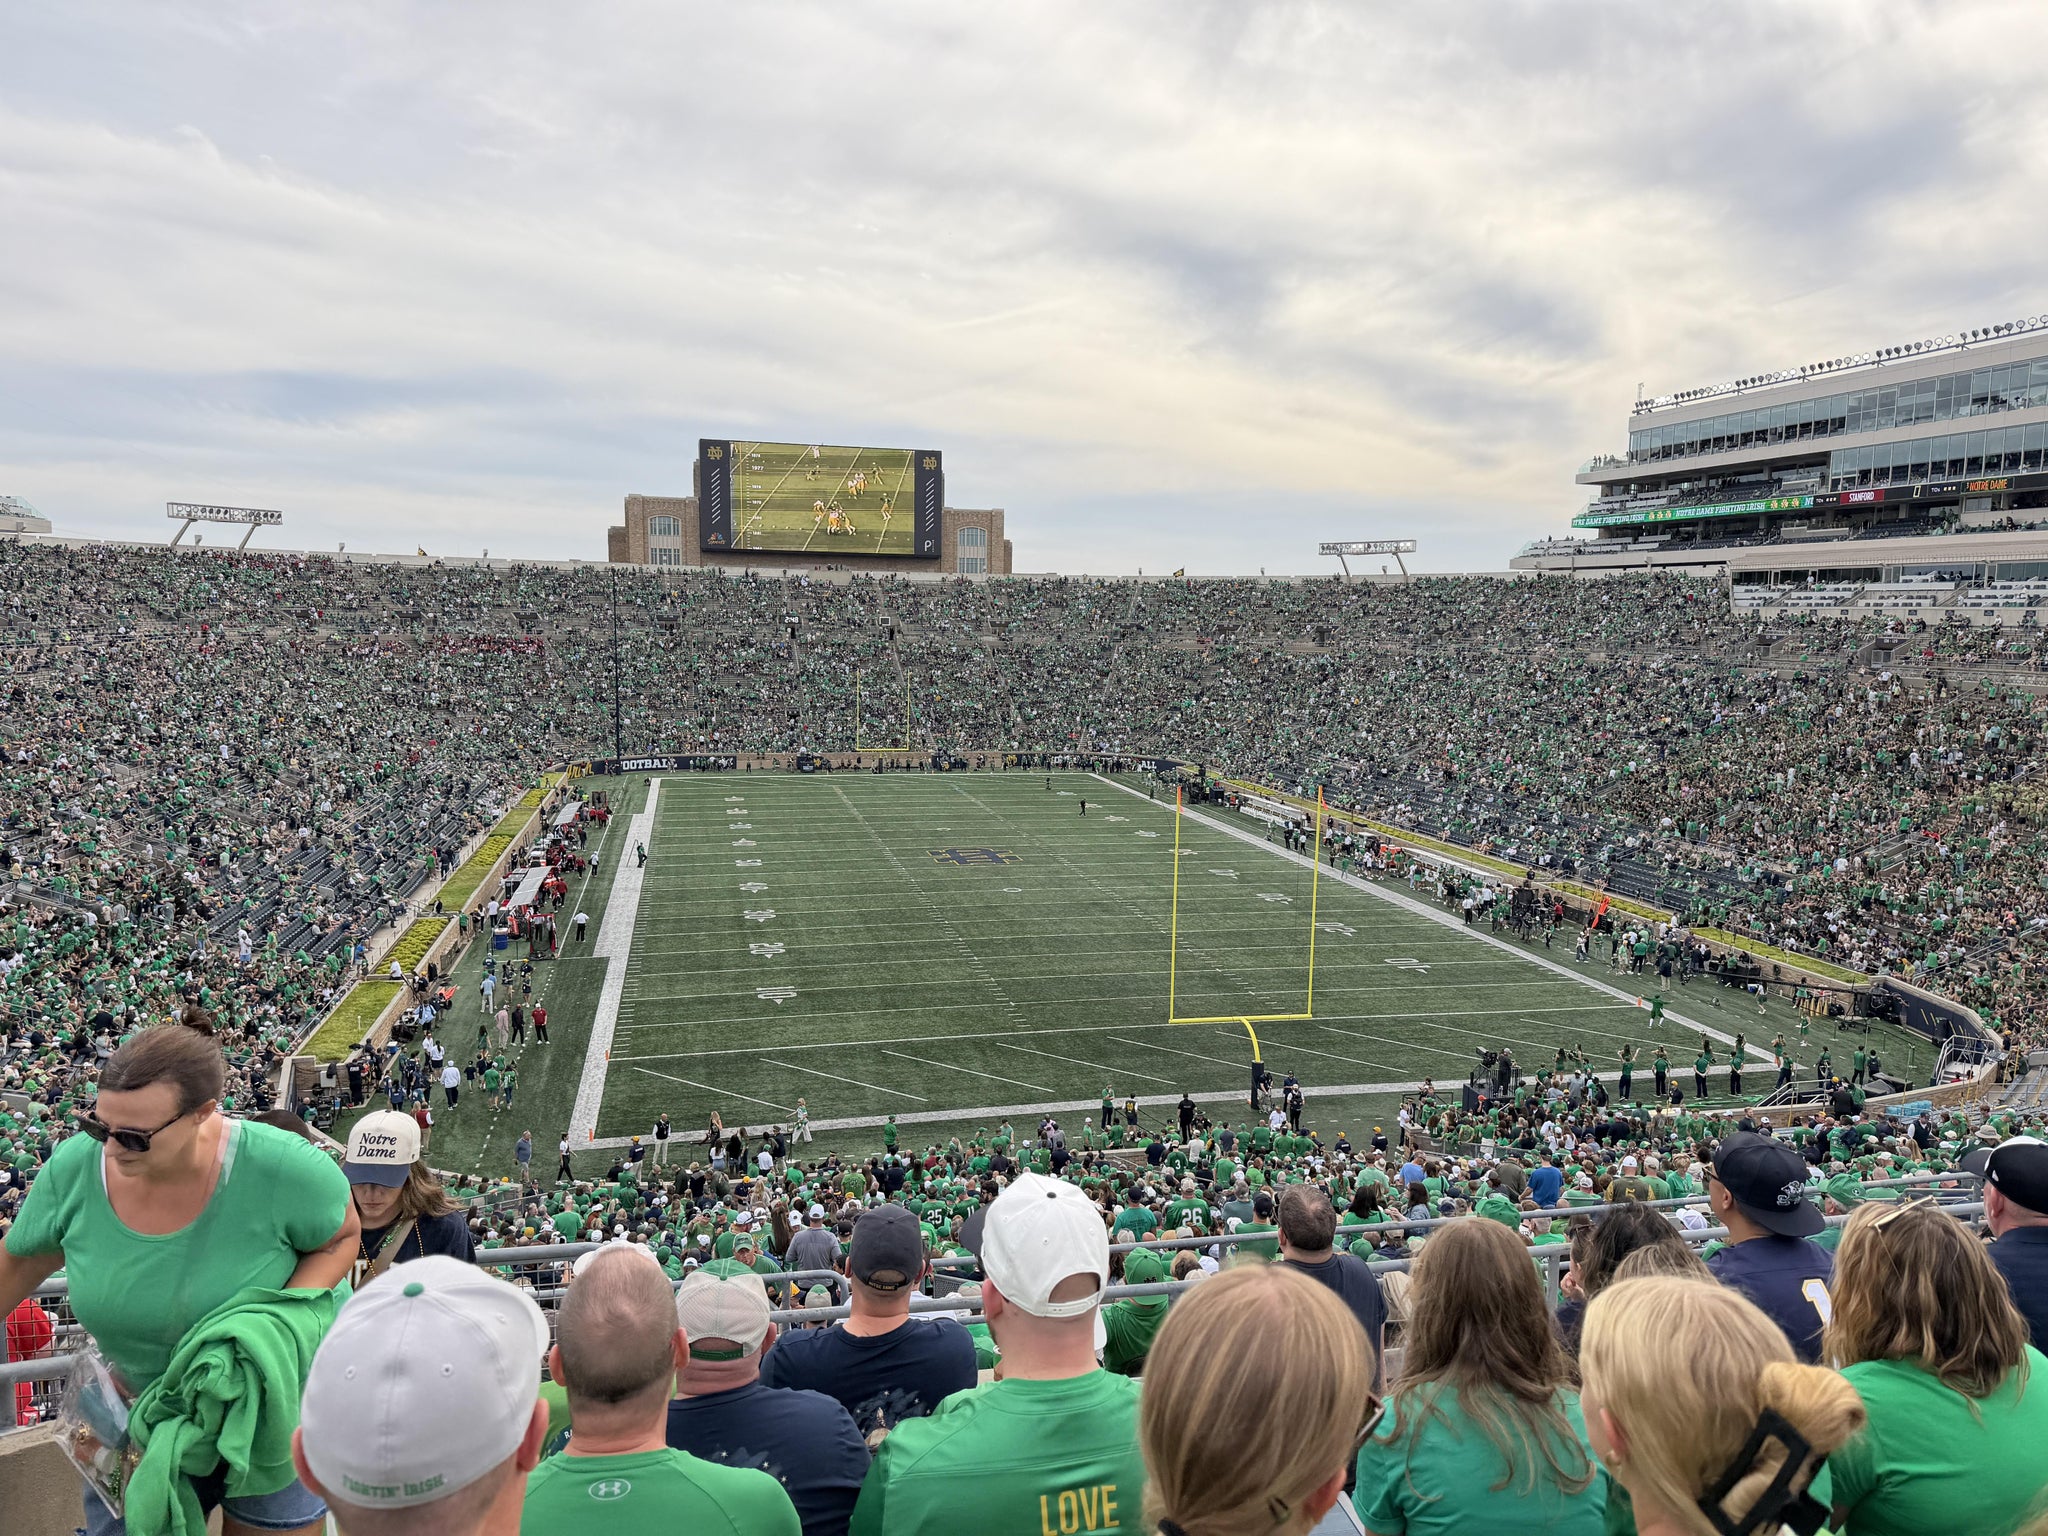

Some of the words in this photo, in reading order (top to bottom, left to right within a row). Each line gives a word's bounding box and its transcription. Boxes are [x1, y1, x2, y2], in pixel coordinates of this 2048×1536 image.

[1969, 480, 1988, 492] NOTRE
[1989, 478, 2008, 490] DAME
[1848, 491, 1875, 503] STANFORD
[1675, 508, 1695, 518] NOTRE
[1695, 506, 1715, 517] DAME
[1715, 503, 1746, 515] FIGHTING
[1745, 501, 1766, 512] IRISH
[784, 616, 799, 624] 2:48
[620, 758, 677, 771] OOTBAL
[359, 1132, 398, 1146] Notre
[356, 1145, 397, 1159] Dame
[1174, 1159, 1181, 1170] 3
[927, 1208, 943, 1225] 25
[1181, 1207, 1203, 1227] 26
[403, 1473, 444, 1497] IRISH
[1039, 1484, 1120, 1536] LOVE
